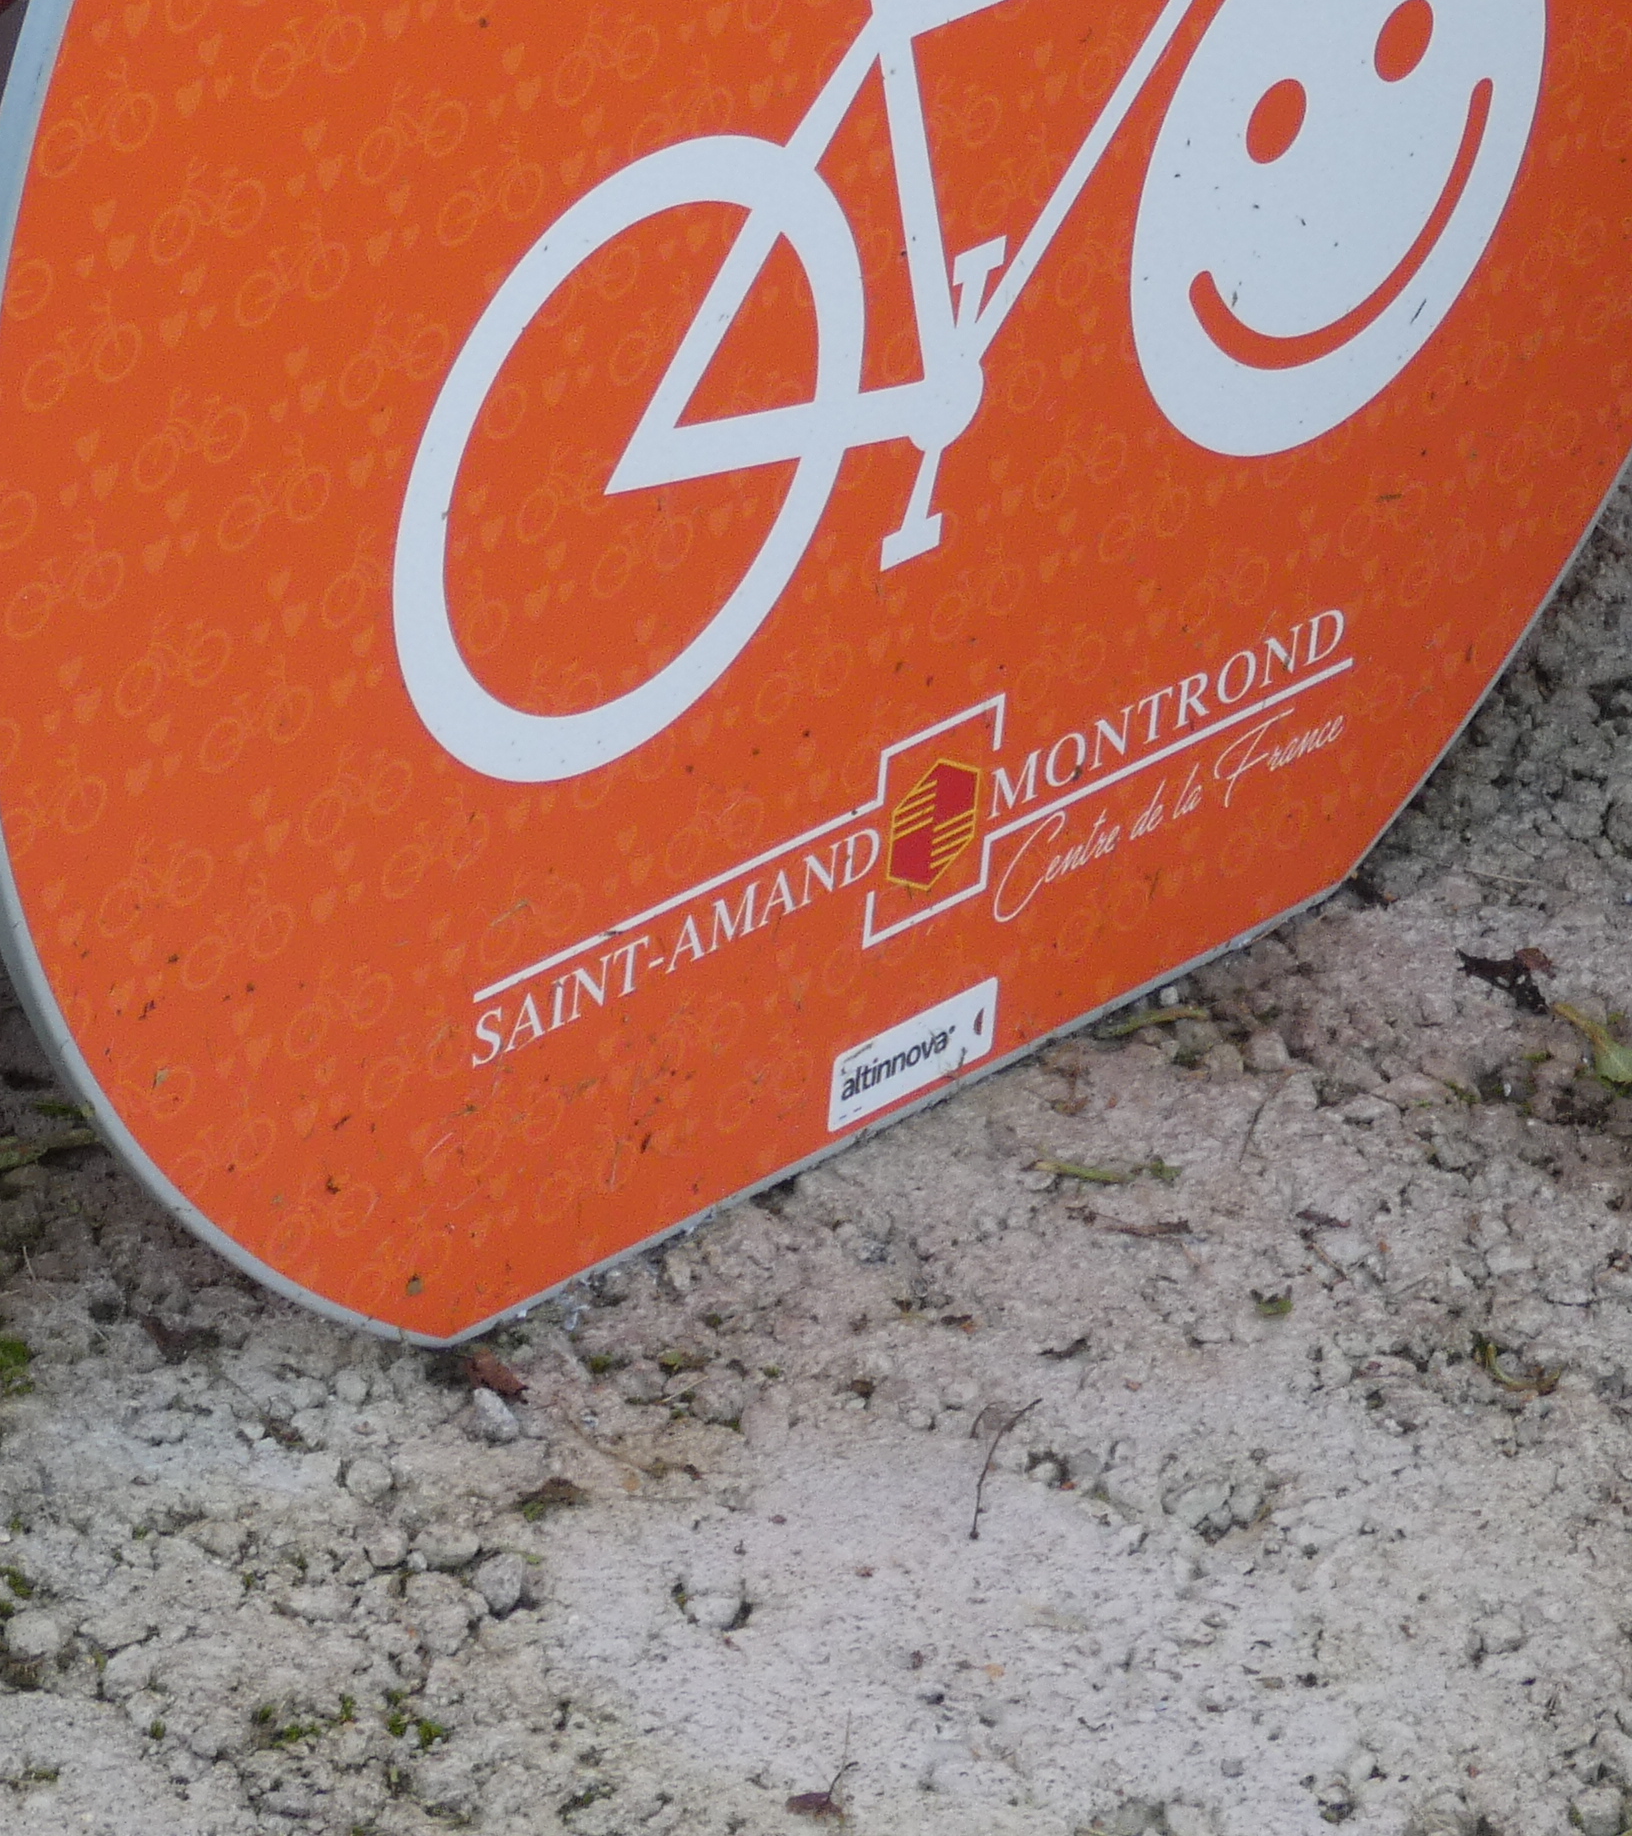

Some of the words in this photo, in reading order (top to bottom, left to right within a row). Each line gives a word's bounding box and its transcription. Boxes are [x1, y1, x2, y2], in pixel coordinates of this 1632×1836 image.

[472, 828, 879, 1067] SAINT-AMAND
[986, 609, 1345, 820] MONTROND
[994, 810, 1121, 922] Centre
[1129, 779, 1166, 841] de
[1173, 763, 1202, 820] la
[1214, 708, 1344, 808] France
